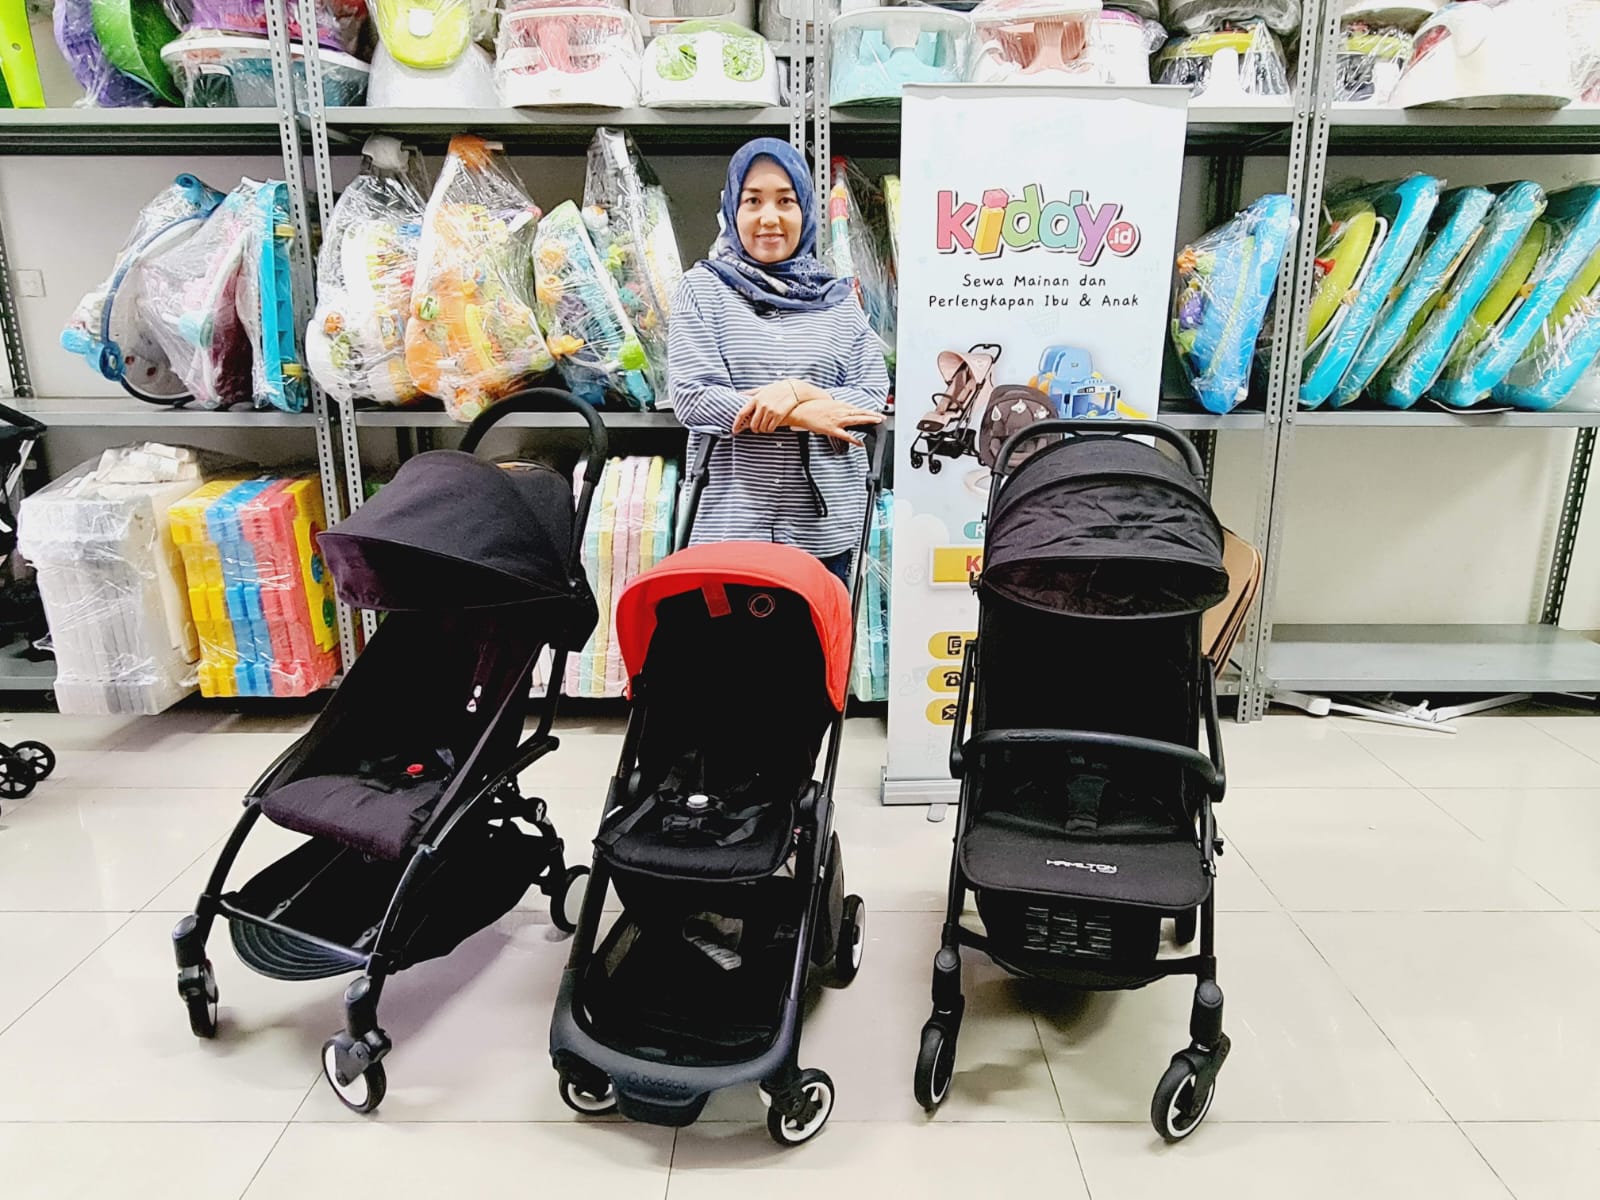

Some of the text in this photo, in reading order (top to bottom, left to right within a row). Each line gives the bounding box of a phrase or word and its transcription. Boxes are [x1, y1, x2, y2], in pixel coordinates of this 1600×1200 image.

[962, 273, 1106, 287] Sewa Mainan dan
[929, 294, 1139, 310] Perlengkapan Ibu & Anak
